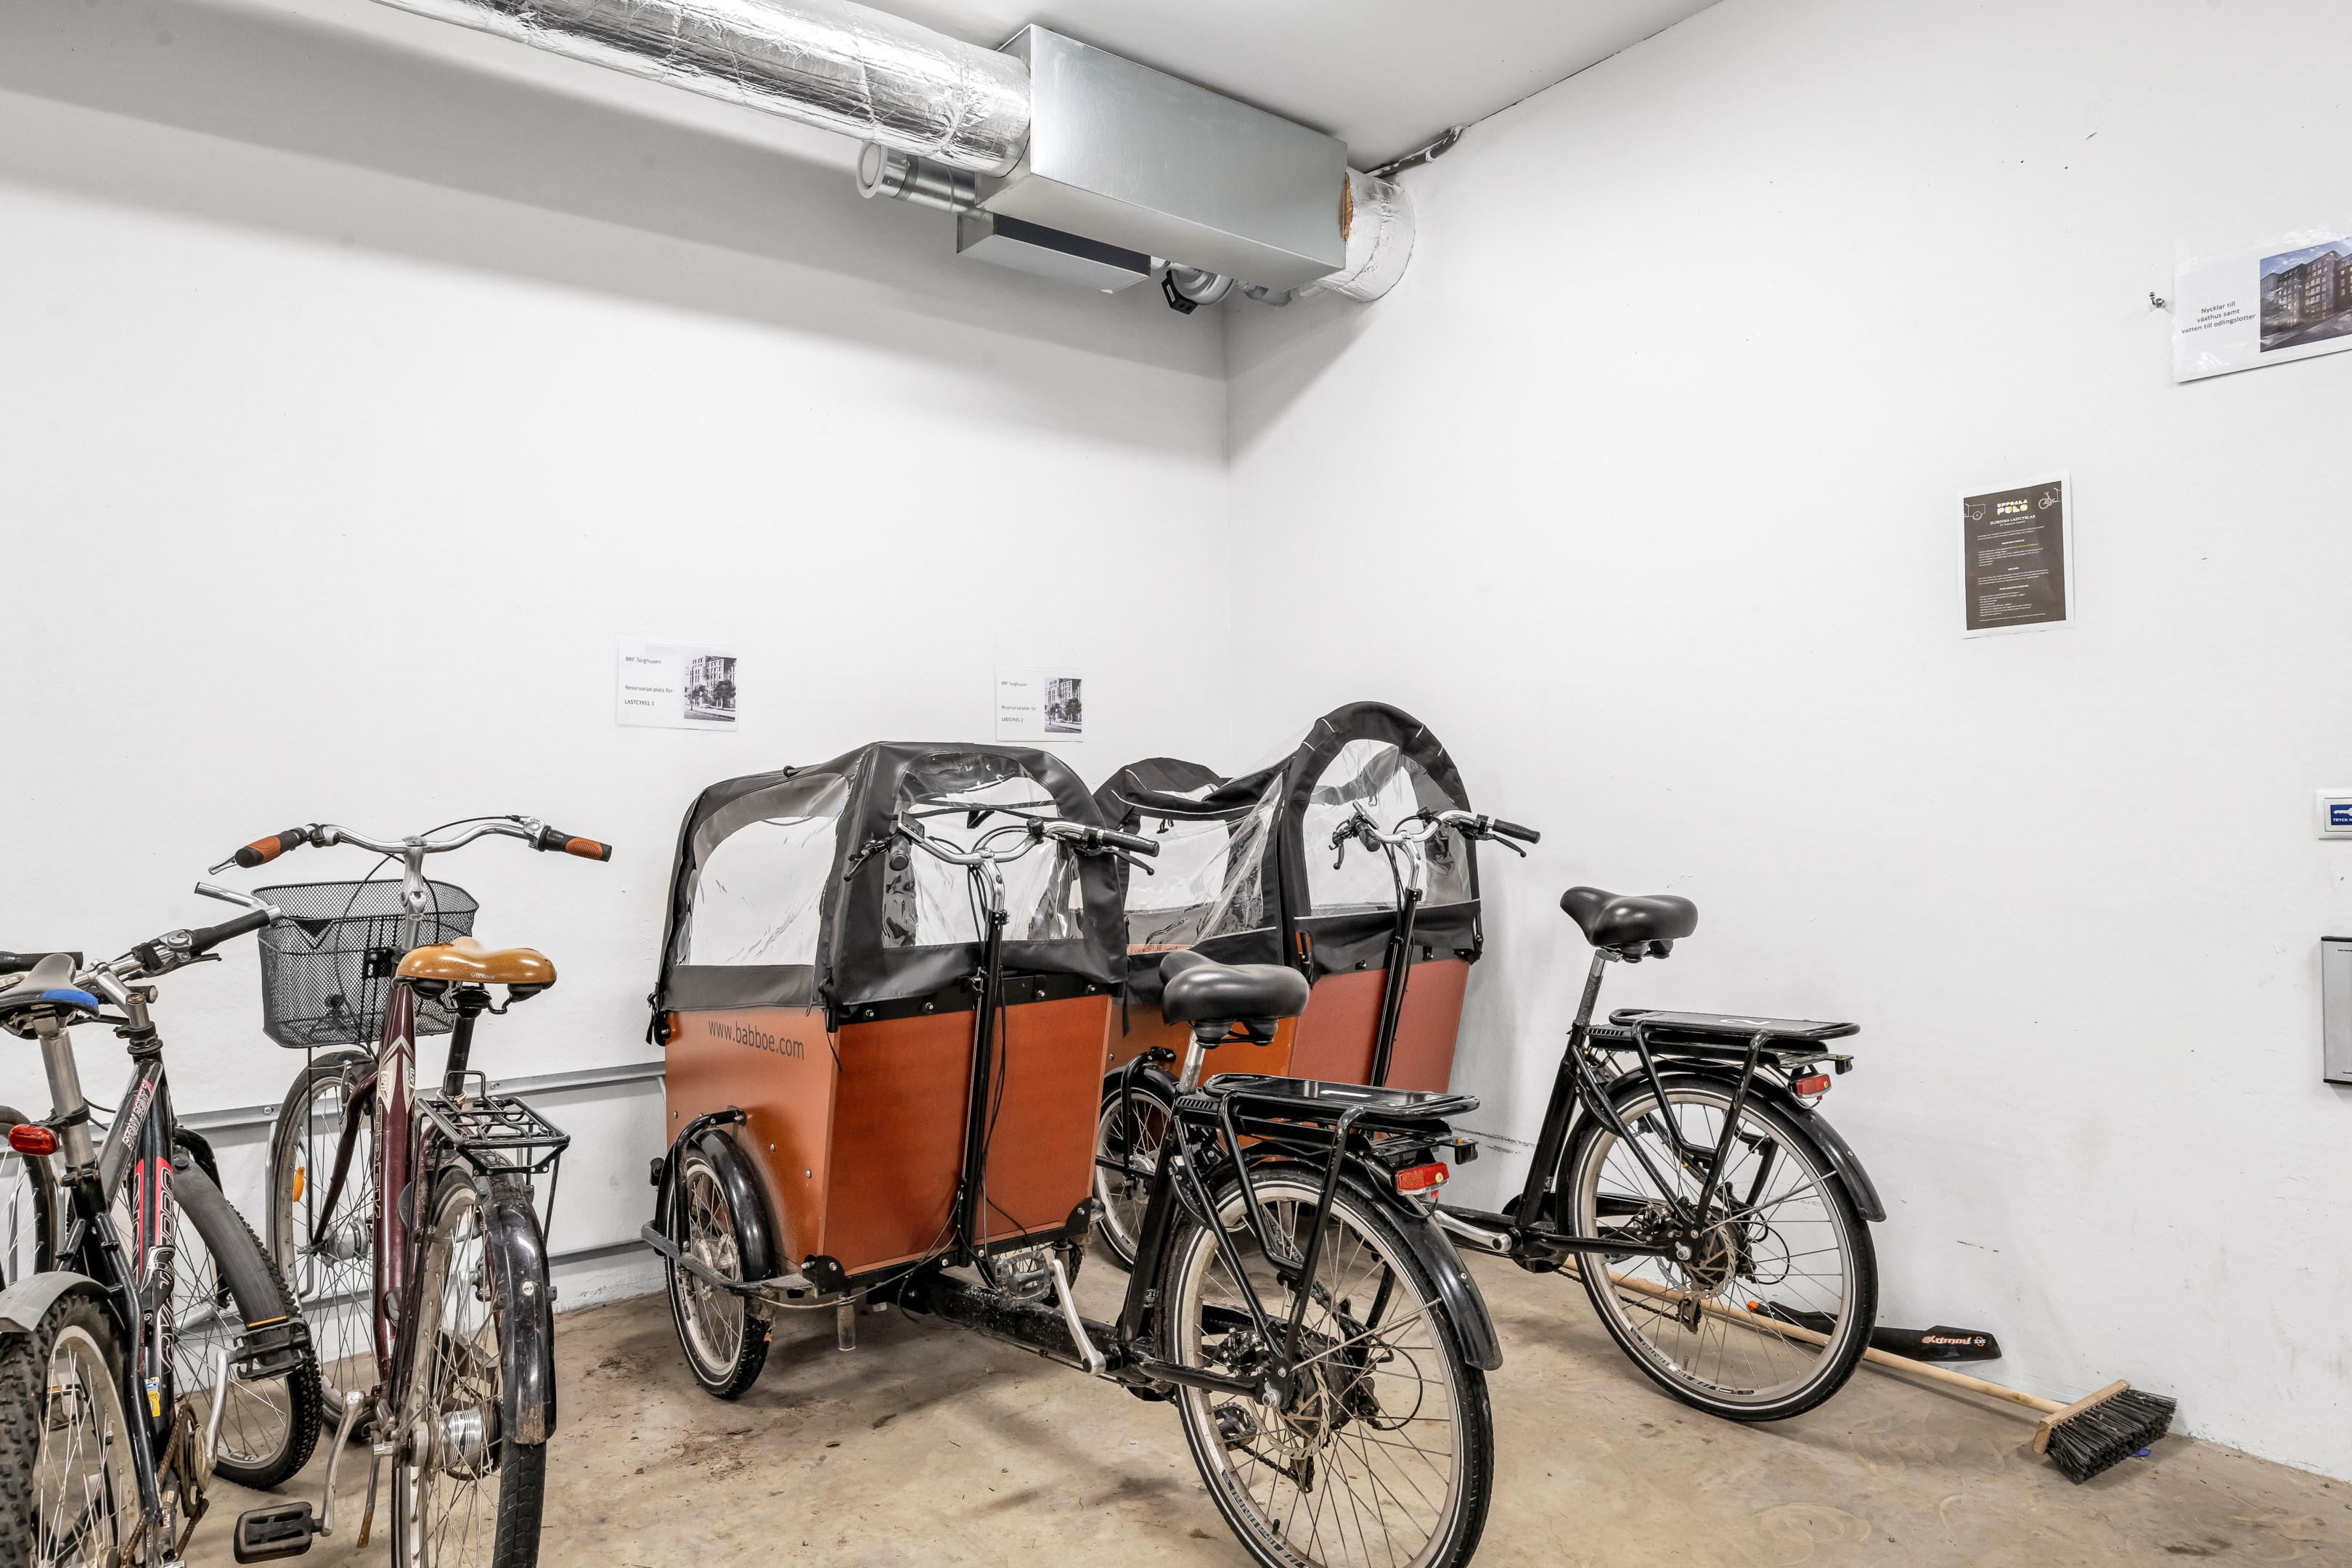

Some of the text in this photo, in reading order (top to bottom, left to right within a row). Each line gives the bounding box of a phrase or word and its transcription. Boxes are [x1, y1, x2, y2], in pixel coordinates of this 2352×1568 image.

[2197, 309, 2240, 323] växthus samt
[2201, 303, 2226, 314] Nycklar
[2181, 324, 2202, 334] vatten
[2213, 314, 2256, 327] odlingslotter
[708, 1019, 805, 1061] www.babboe.com
[122, 1116, 142, 1151] STONY
